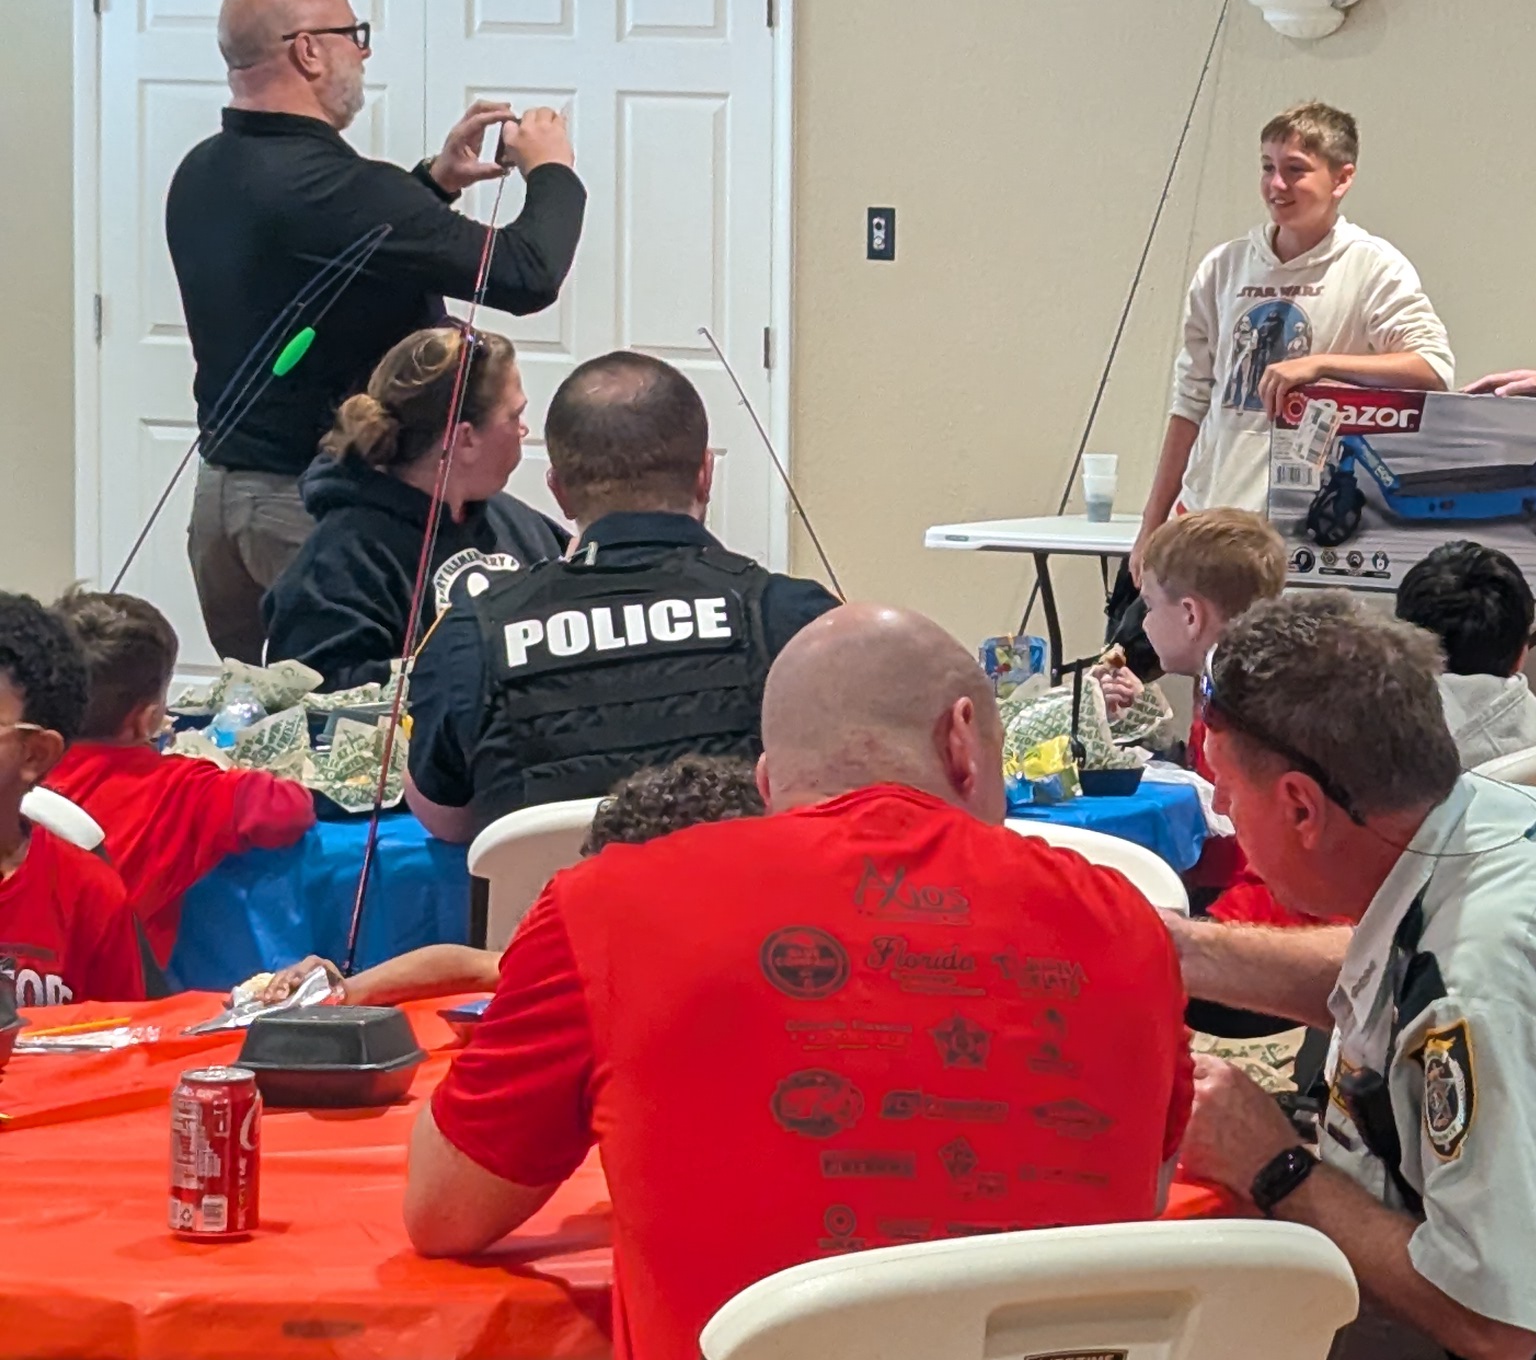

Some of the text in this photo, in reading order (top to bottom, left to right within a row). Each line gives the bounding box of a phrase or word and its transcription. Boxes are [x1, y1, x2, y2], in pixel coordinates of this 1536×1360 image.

[1236, 285, 1326, 298] STAR WARS
[503, 596, 733, 668] POLICE
